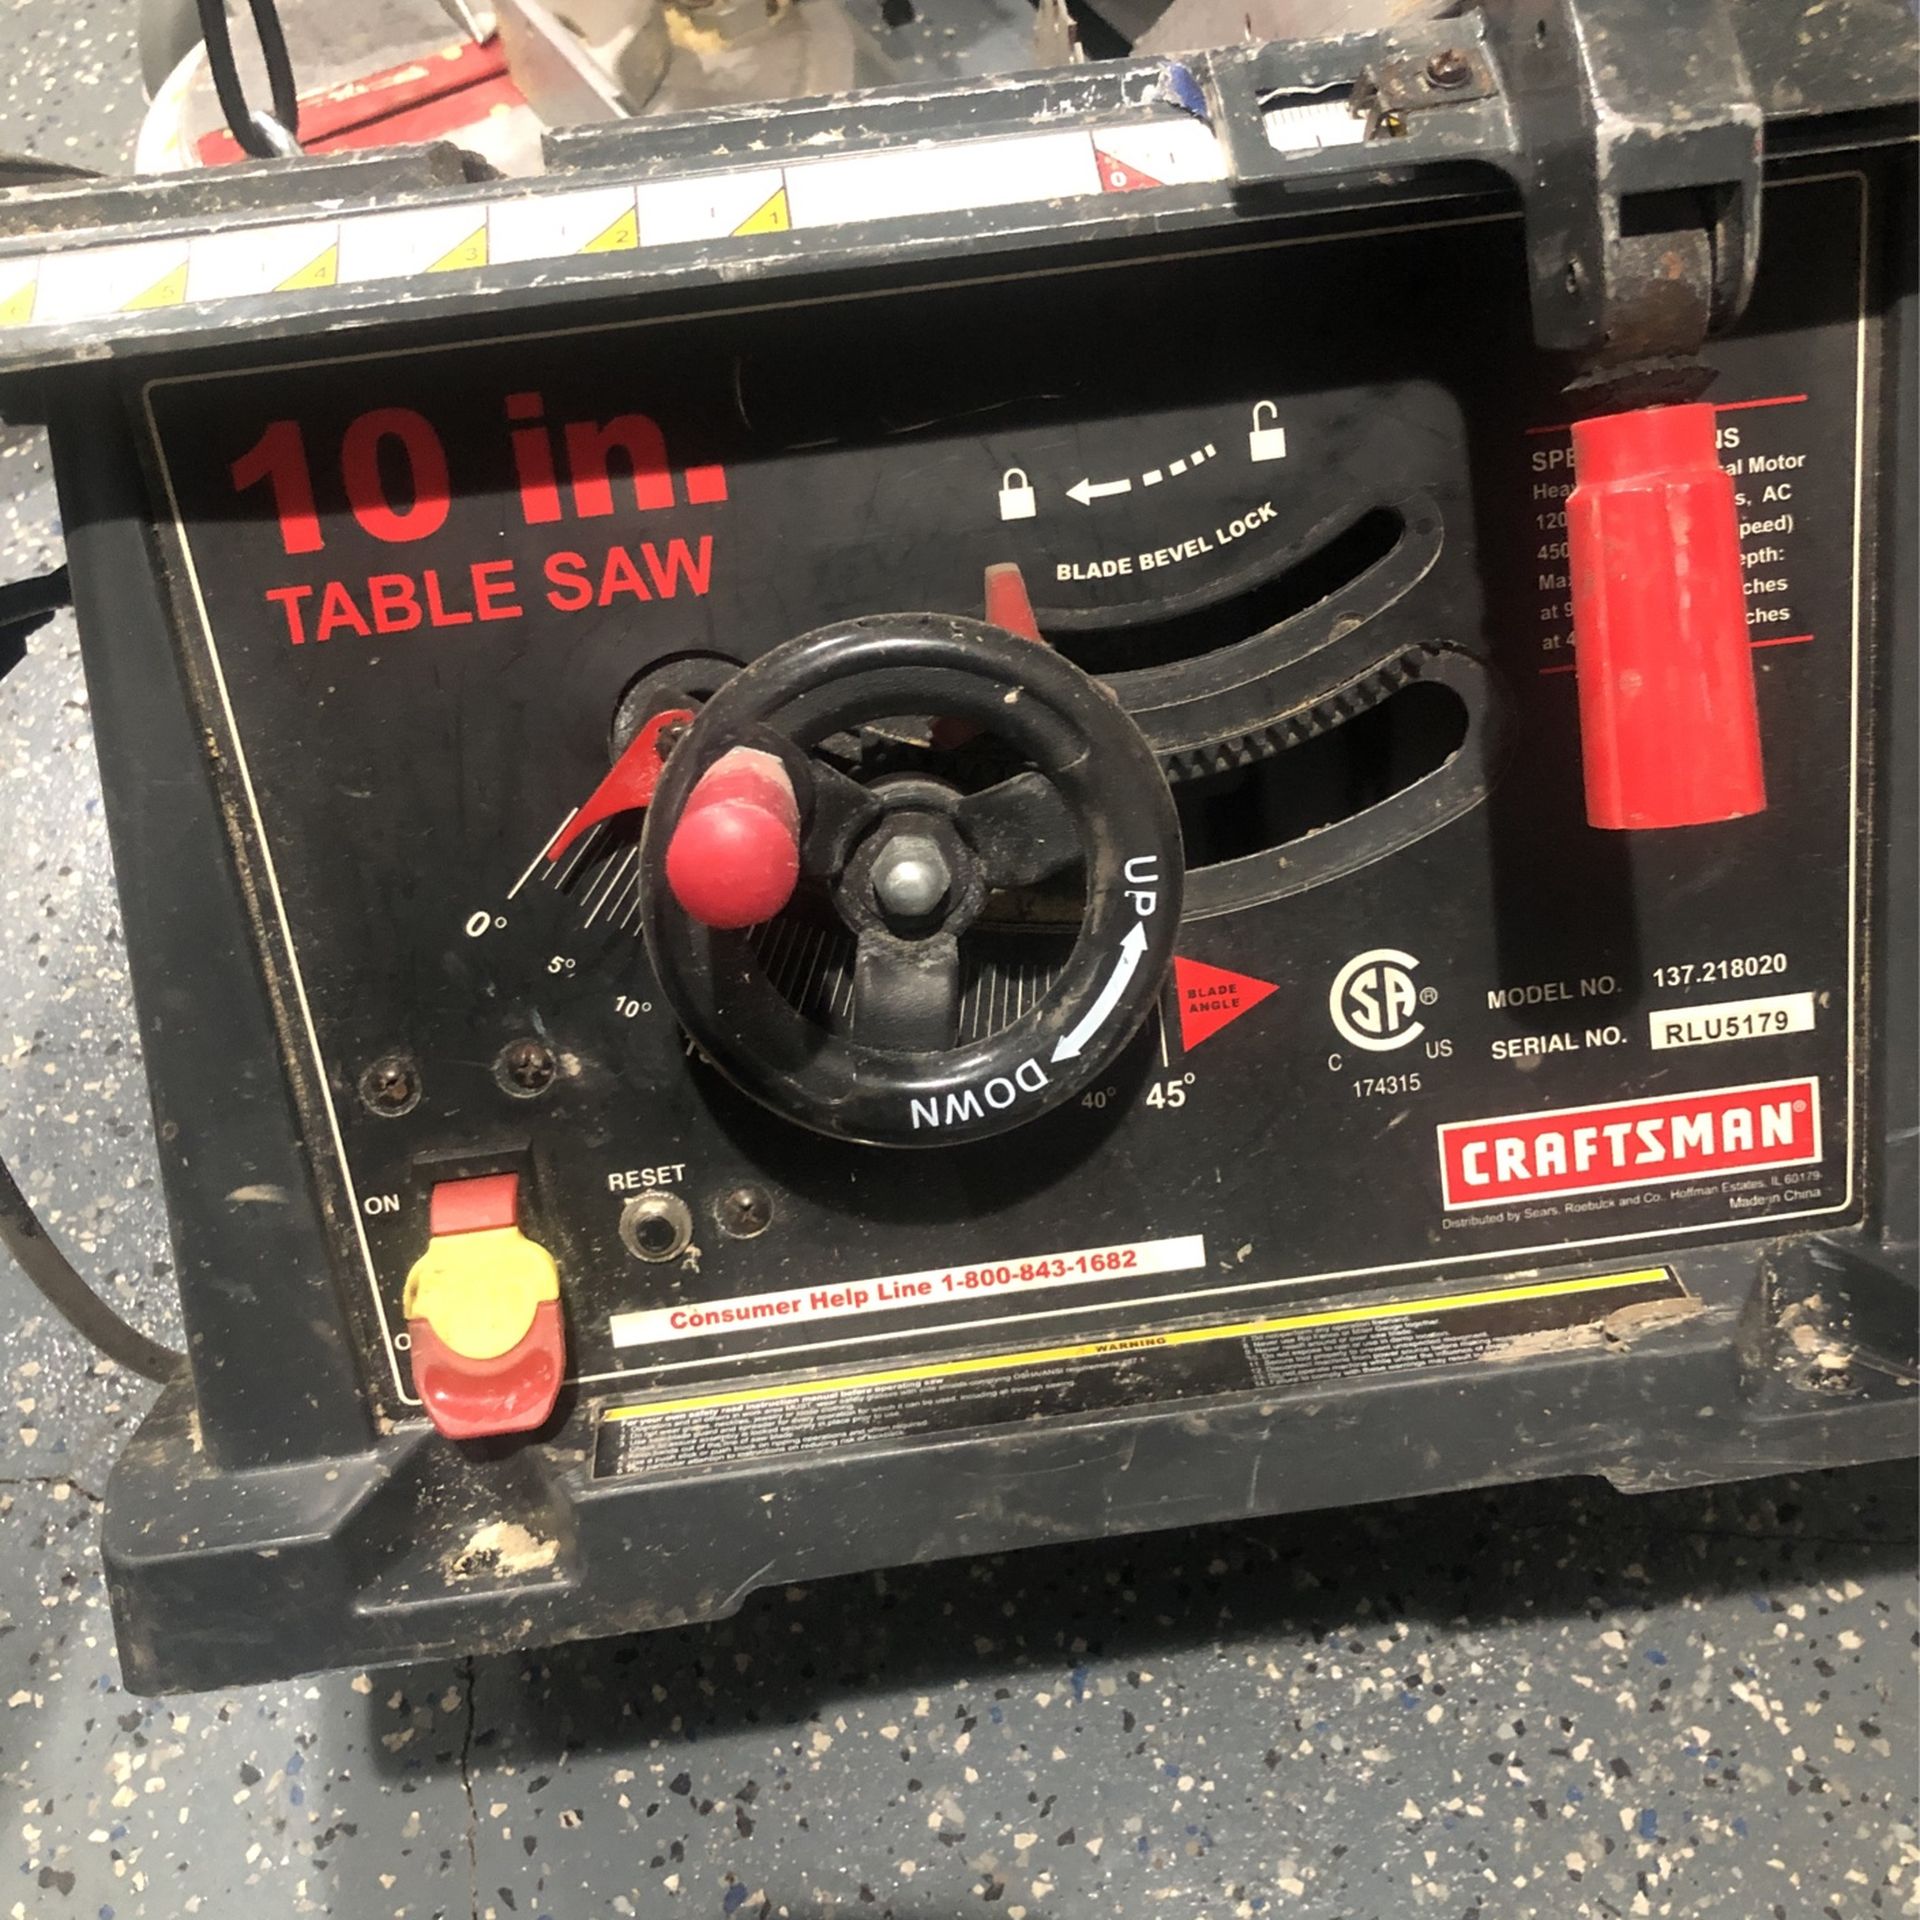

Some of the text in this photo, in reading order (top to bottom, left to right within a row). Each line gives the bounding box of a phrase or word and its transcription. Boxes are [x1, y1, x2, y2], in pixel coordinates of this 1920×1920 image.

[769, 211, 779, 225] 1
[615, 230, 629, 244] 2
[465, 247, 478, 261] 3
[230, 392, 728, 554] 10 in.
[1748, 454, 1806, 474] Motor
[1762, 483, 1792, 503] AC
[1740, 513, 1794, 540] peed)
[1056, 501, 1278, 581] BLADE BEVEL LOCK
[1740, 546, 1785, 569] epth:
[265, 535, 713, 645] TABLE SAW
[1540, 604, 1558, 621] at
[1743, 578, 1789, 595] ches
[1542, 634, 1560, 651] at
[1745, 607, 1791, 625] ches
[1124, 855, 1159, 916] UP
[1187, 984, 1237, 999] BLADE
[1488, 953, 1788, 1010] MODEL NO. 137.218020
[1189, 997, 1240, 1014] ANGLE
[1490, 1010, 1789, 1061] SERIAL NO. RLU5179
[1328, 1053, 1343, 1072] C
[1426, 1039, 1453, 1060] US
[910, 1058, 1048, 1129] DOWN
[1353, 1072, 1422, 1098] 174315
[608, 1164, 686, 1191] RESET
[364, 1194, 400, 1215] ON
[1442, 1212, 1504, 1230] Distributed
[1507, 1211, 1520, 1223] by
[1564, 1198, 1615, 1213] Roebuck
[1619, 1194, 1641, 1207] and
[1670, 1185, 1718, 1200] Hoffman
[1729, 1194, 1765, 1210] Made
[1784, 1187, 1821, 1202] China
[670, 1249, 1138, 1330] Consumer Help Line 1-800-843-1682
[1095, 1337, 1167, 1354] WARNING
